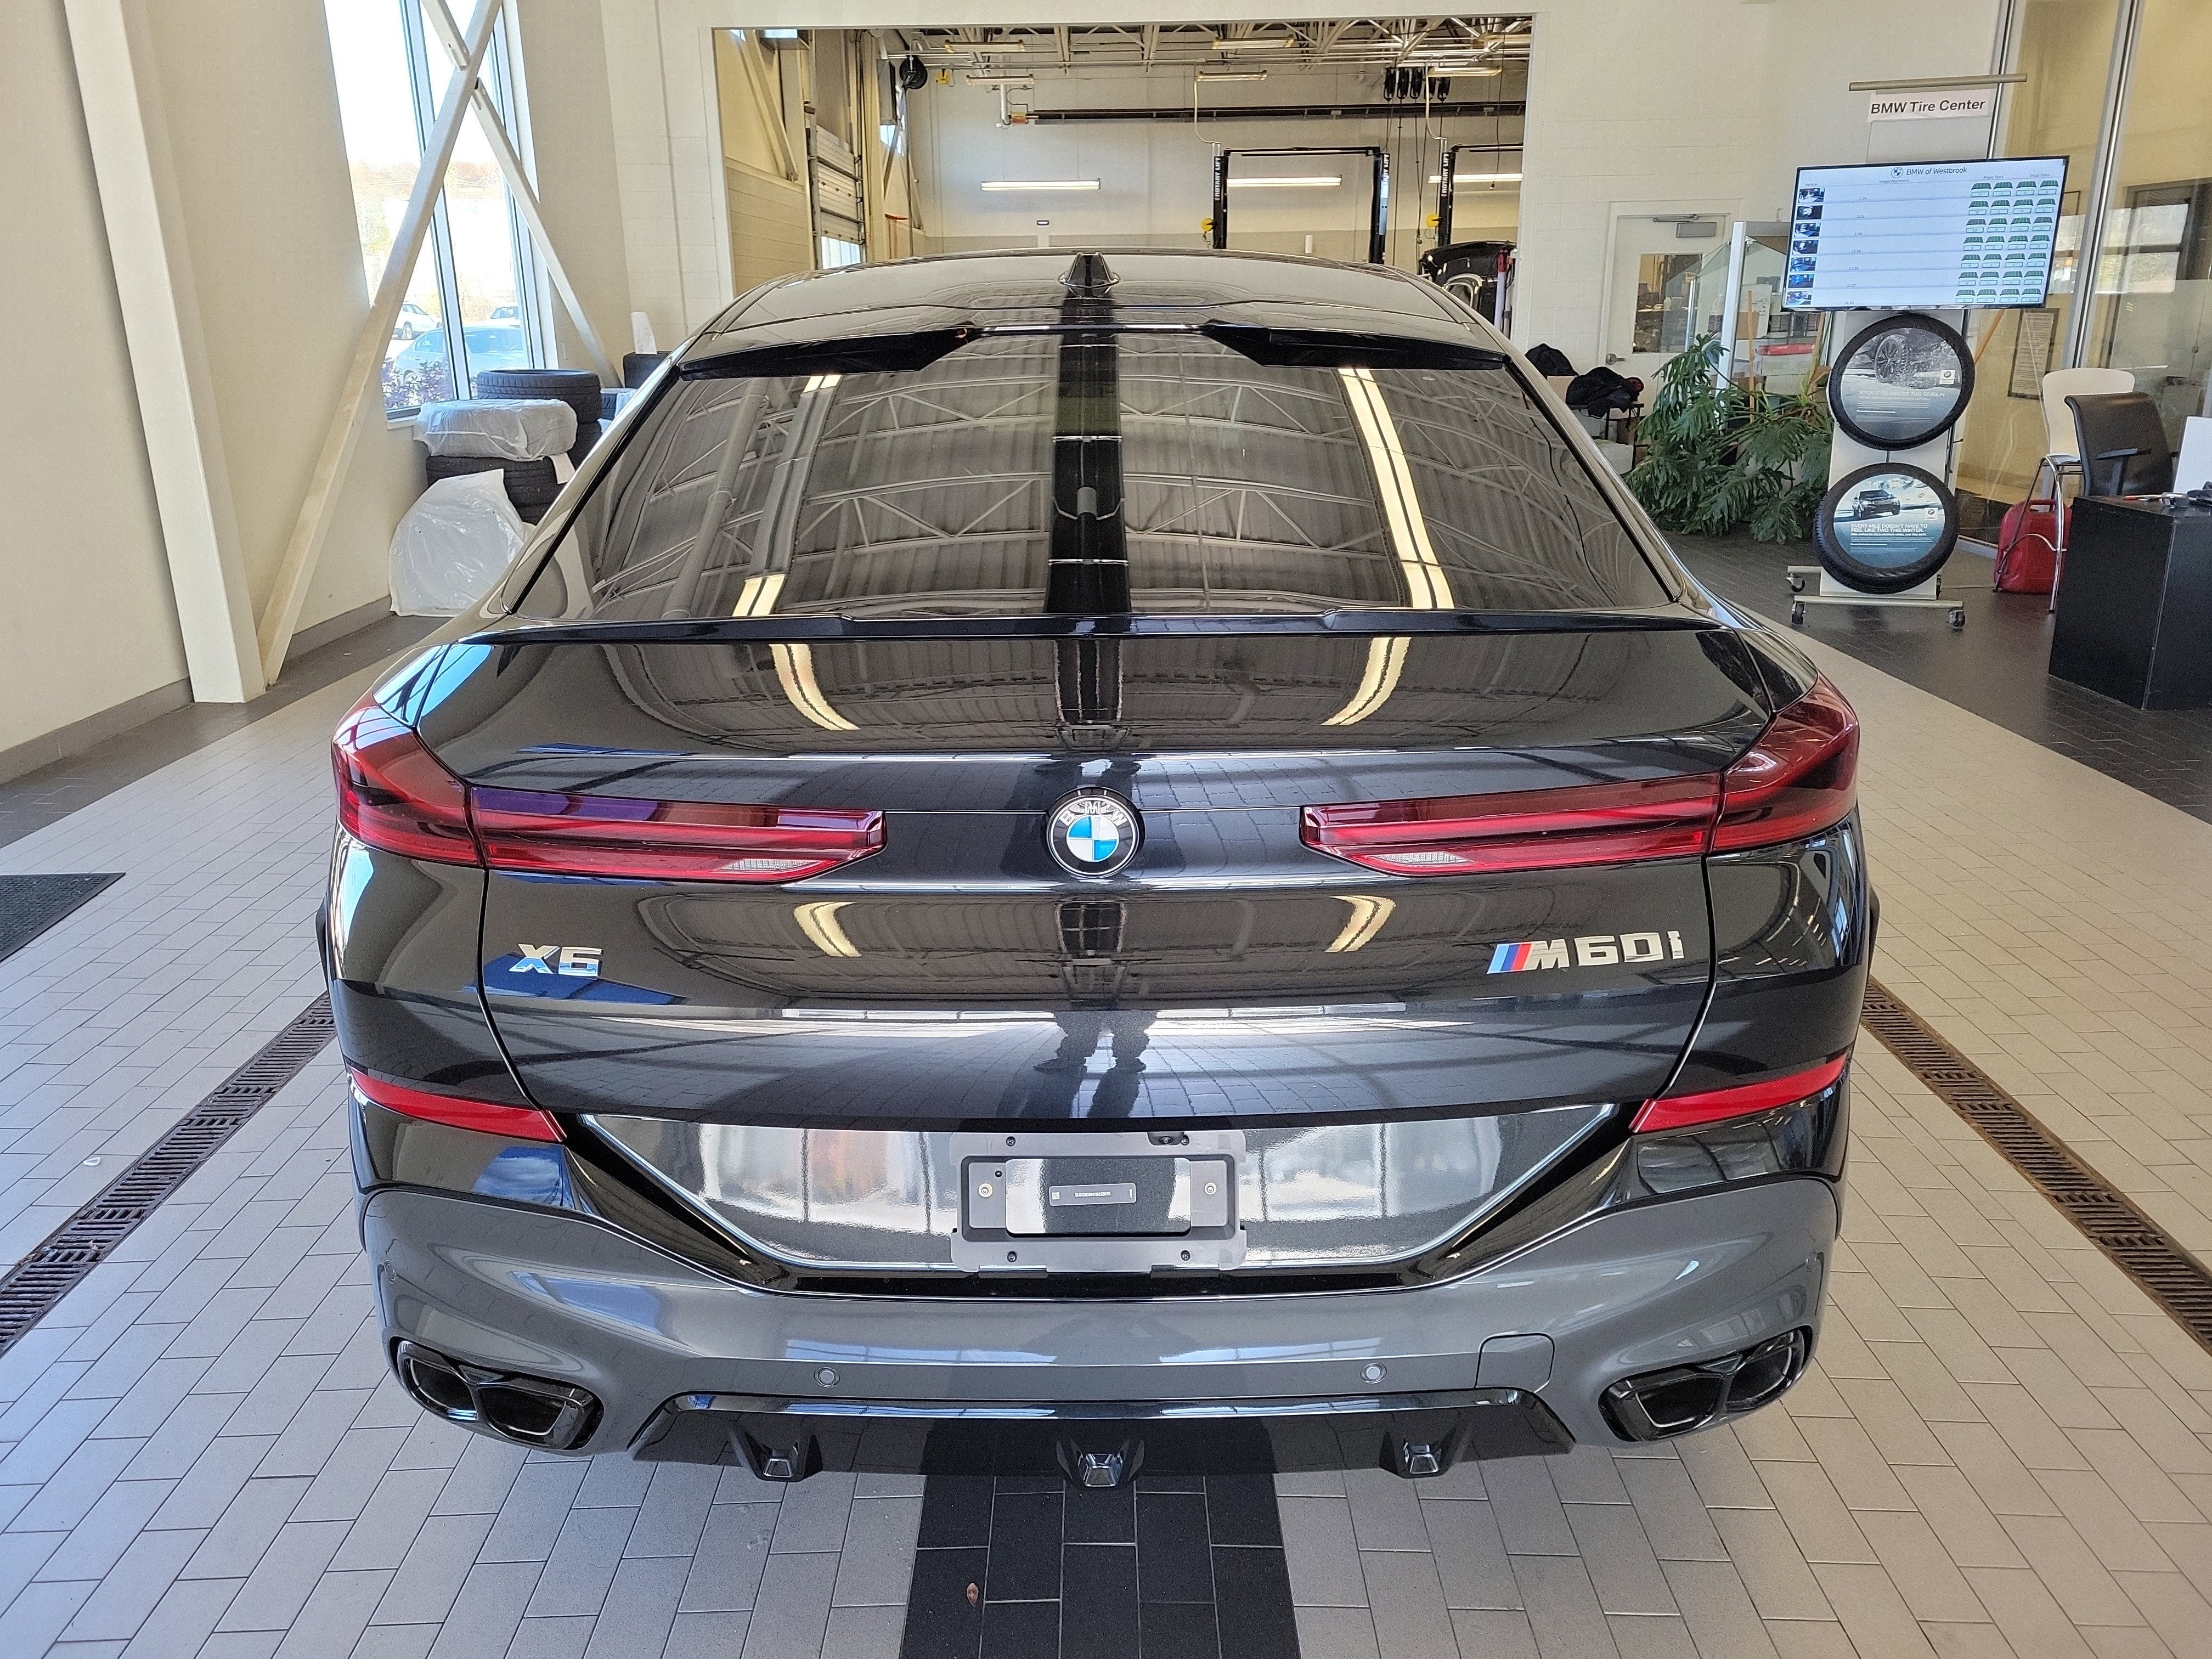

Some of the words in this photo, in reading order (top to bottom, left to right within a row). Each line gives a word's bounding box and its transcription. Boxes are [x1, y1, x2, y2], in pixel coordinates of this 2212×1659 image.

[1871, 101, 1908, 114] BMW
[1910, 101, 1936, 112] Tire
[1939, 100, 1986, 111] Center
[1058, 801, 1128, 827] BMW
[508, 943, 603, 977] X6
[1523, 930, 1685, 970] M60i
